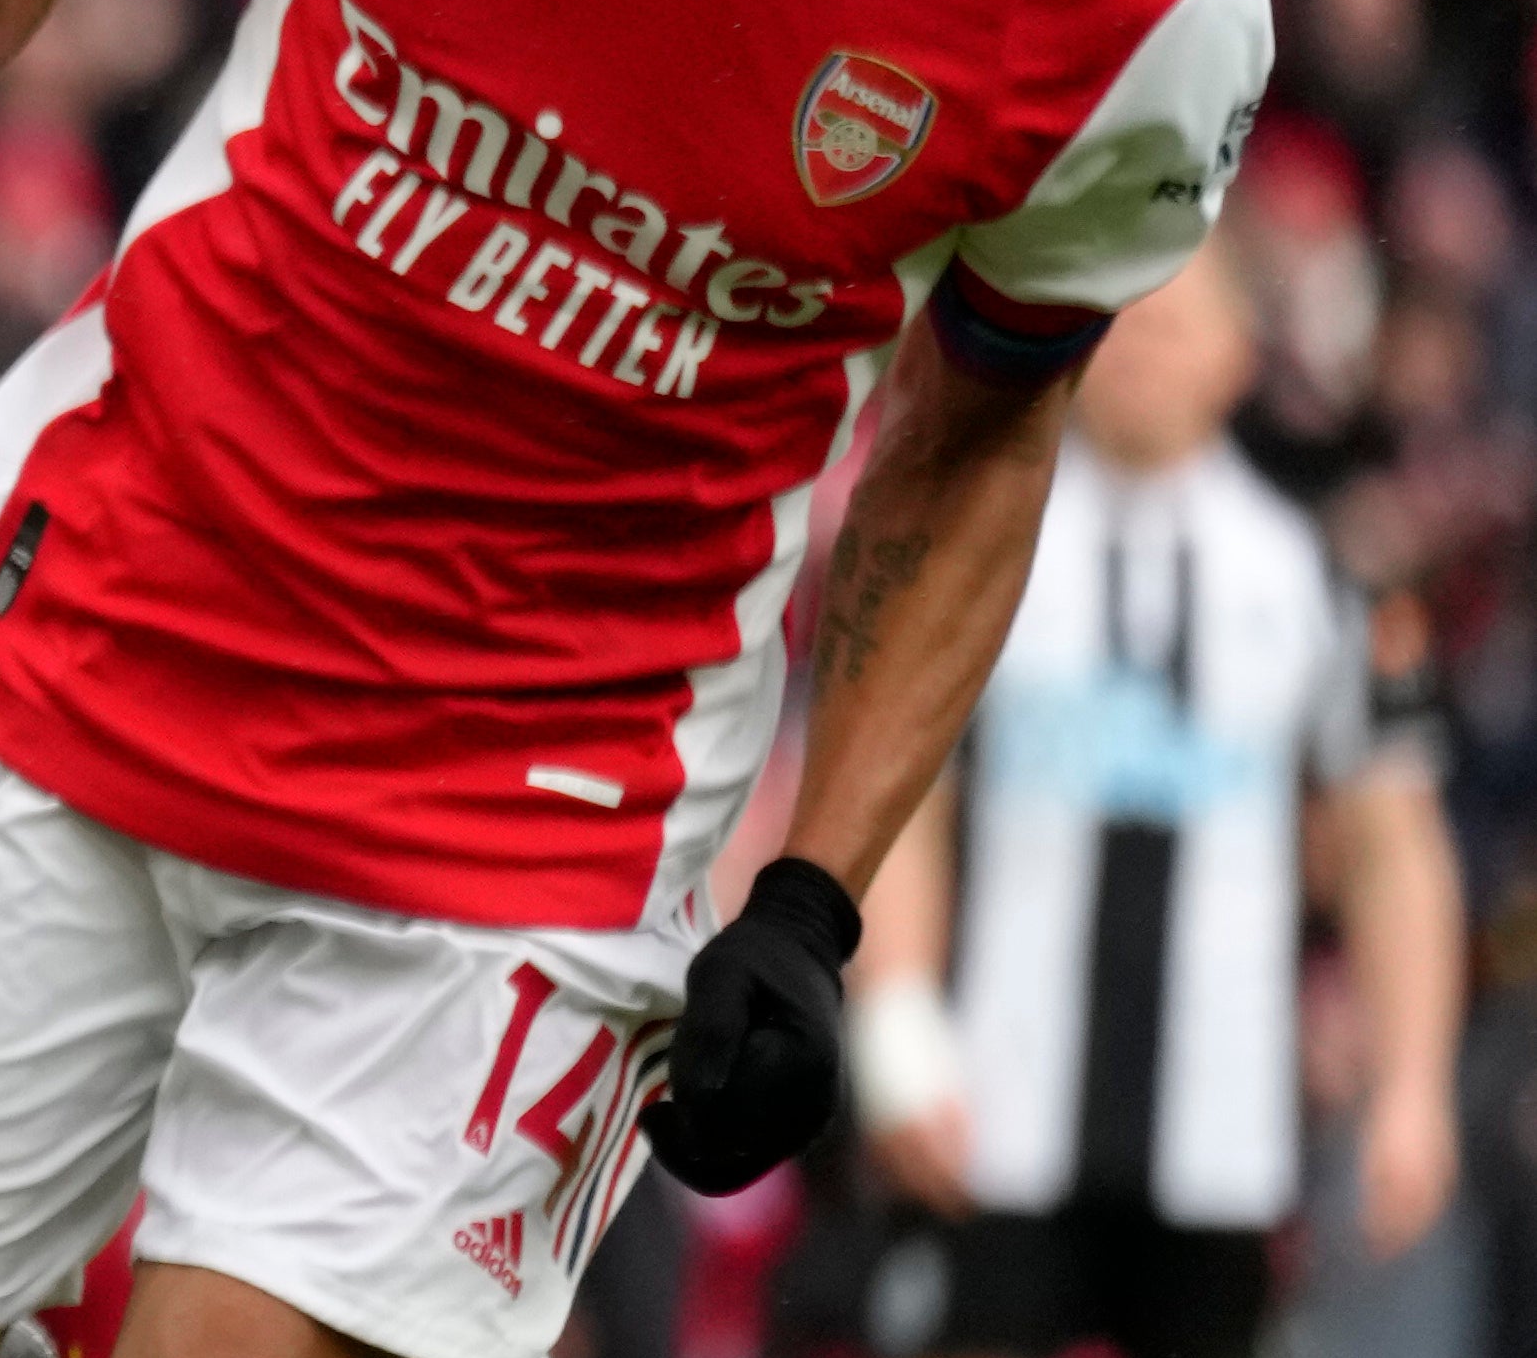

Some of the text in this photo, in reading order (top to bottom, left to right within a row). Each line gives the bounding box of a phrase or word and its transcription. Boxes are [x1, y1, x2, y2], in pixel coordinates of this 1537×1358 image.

[828, 72, 922, 130] Arsenal
[333, 148, 721, 400] FLY BETTER
[453, 1229, 524, 1302] adidas
